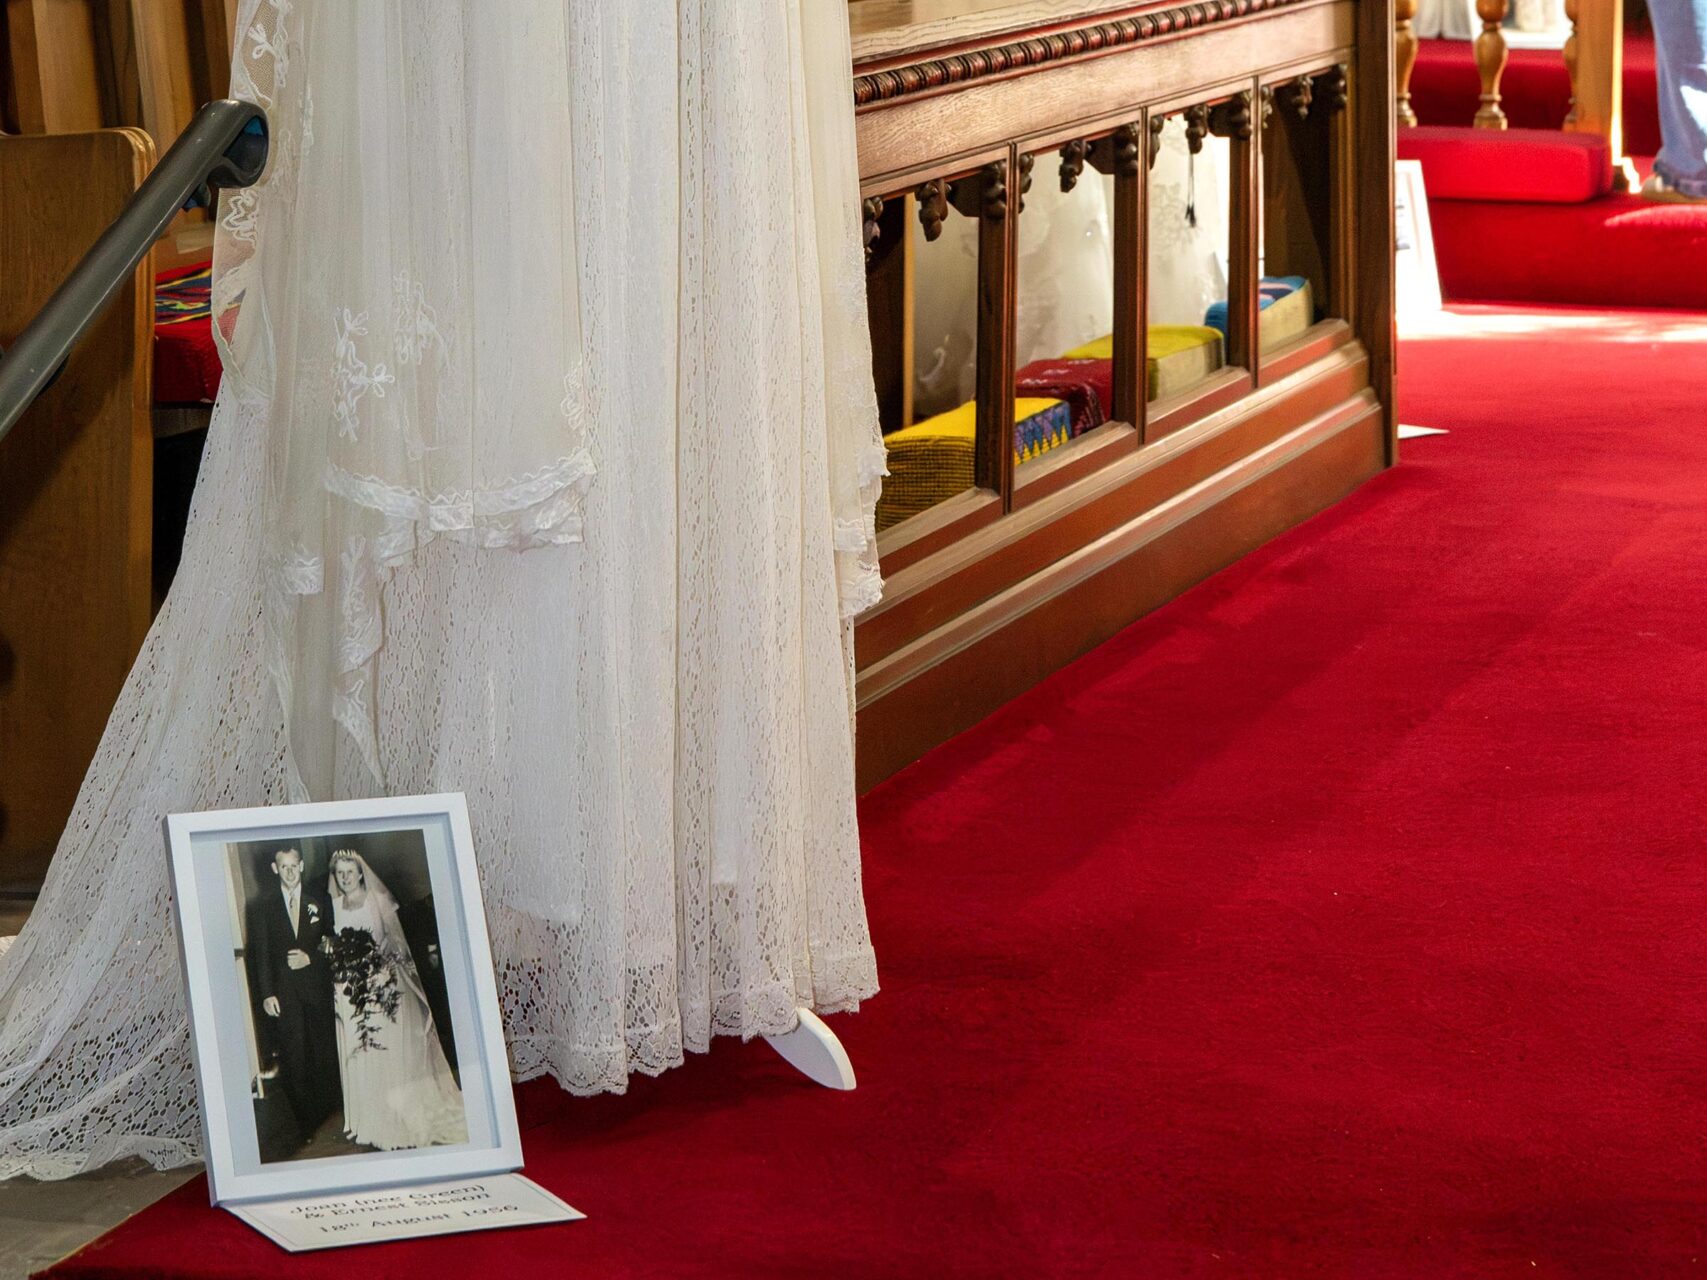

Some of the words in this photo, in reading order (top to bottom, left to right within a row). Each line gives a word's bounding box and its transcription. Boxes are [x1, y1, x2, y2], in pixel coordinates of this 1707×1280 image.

[290, 1202, 347, 1215] Joan
[408, 1184, 485, 1200] Green)
[331, 1203, 407, 1216] Ernest
[371, 1213, 450, 1229] August
